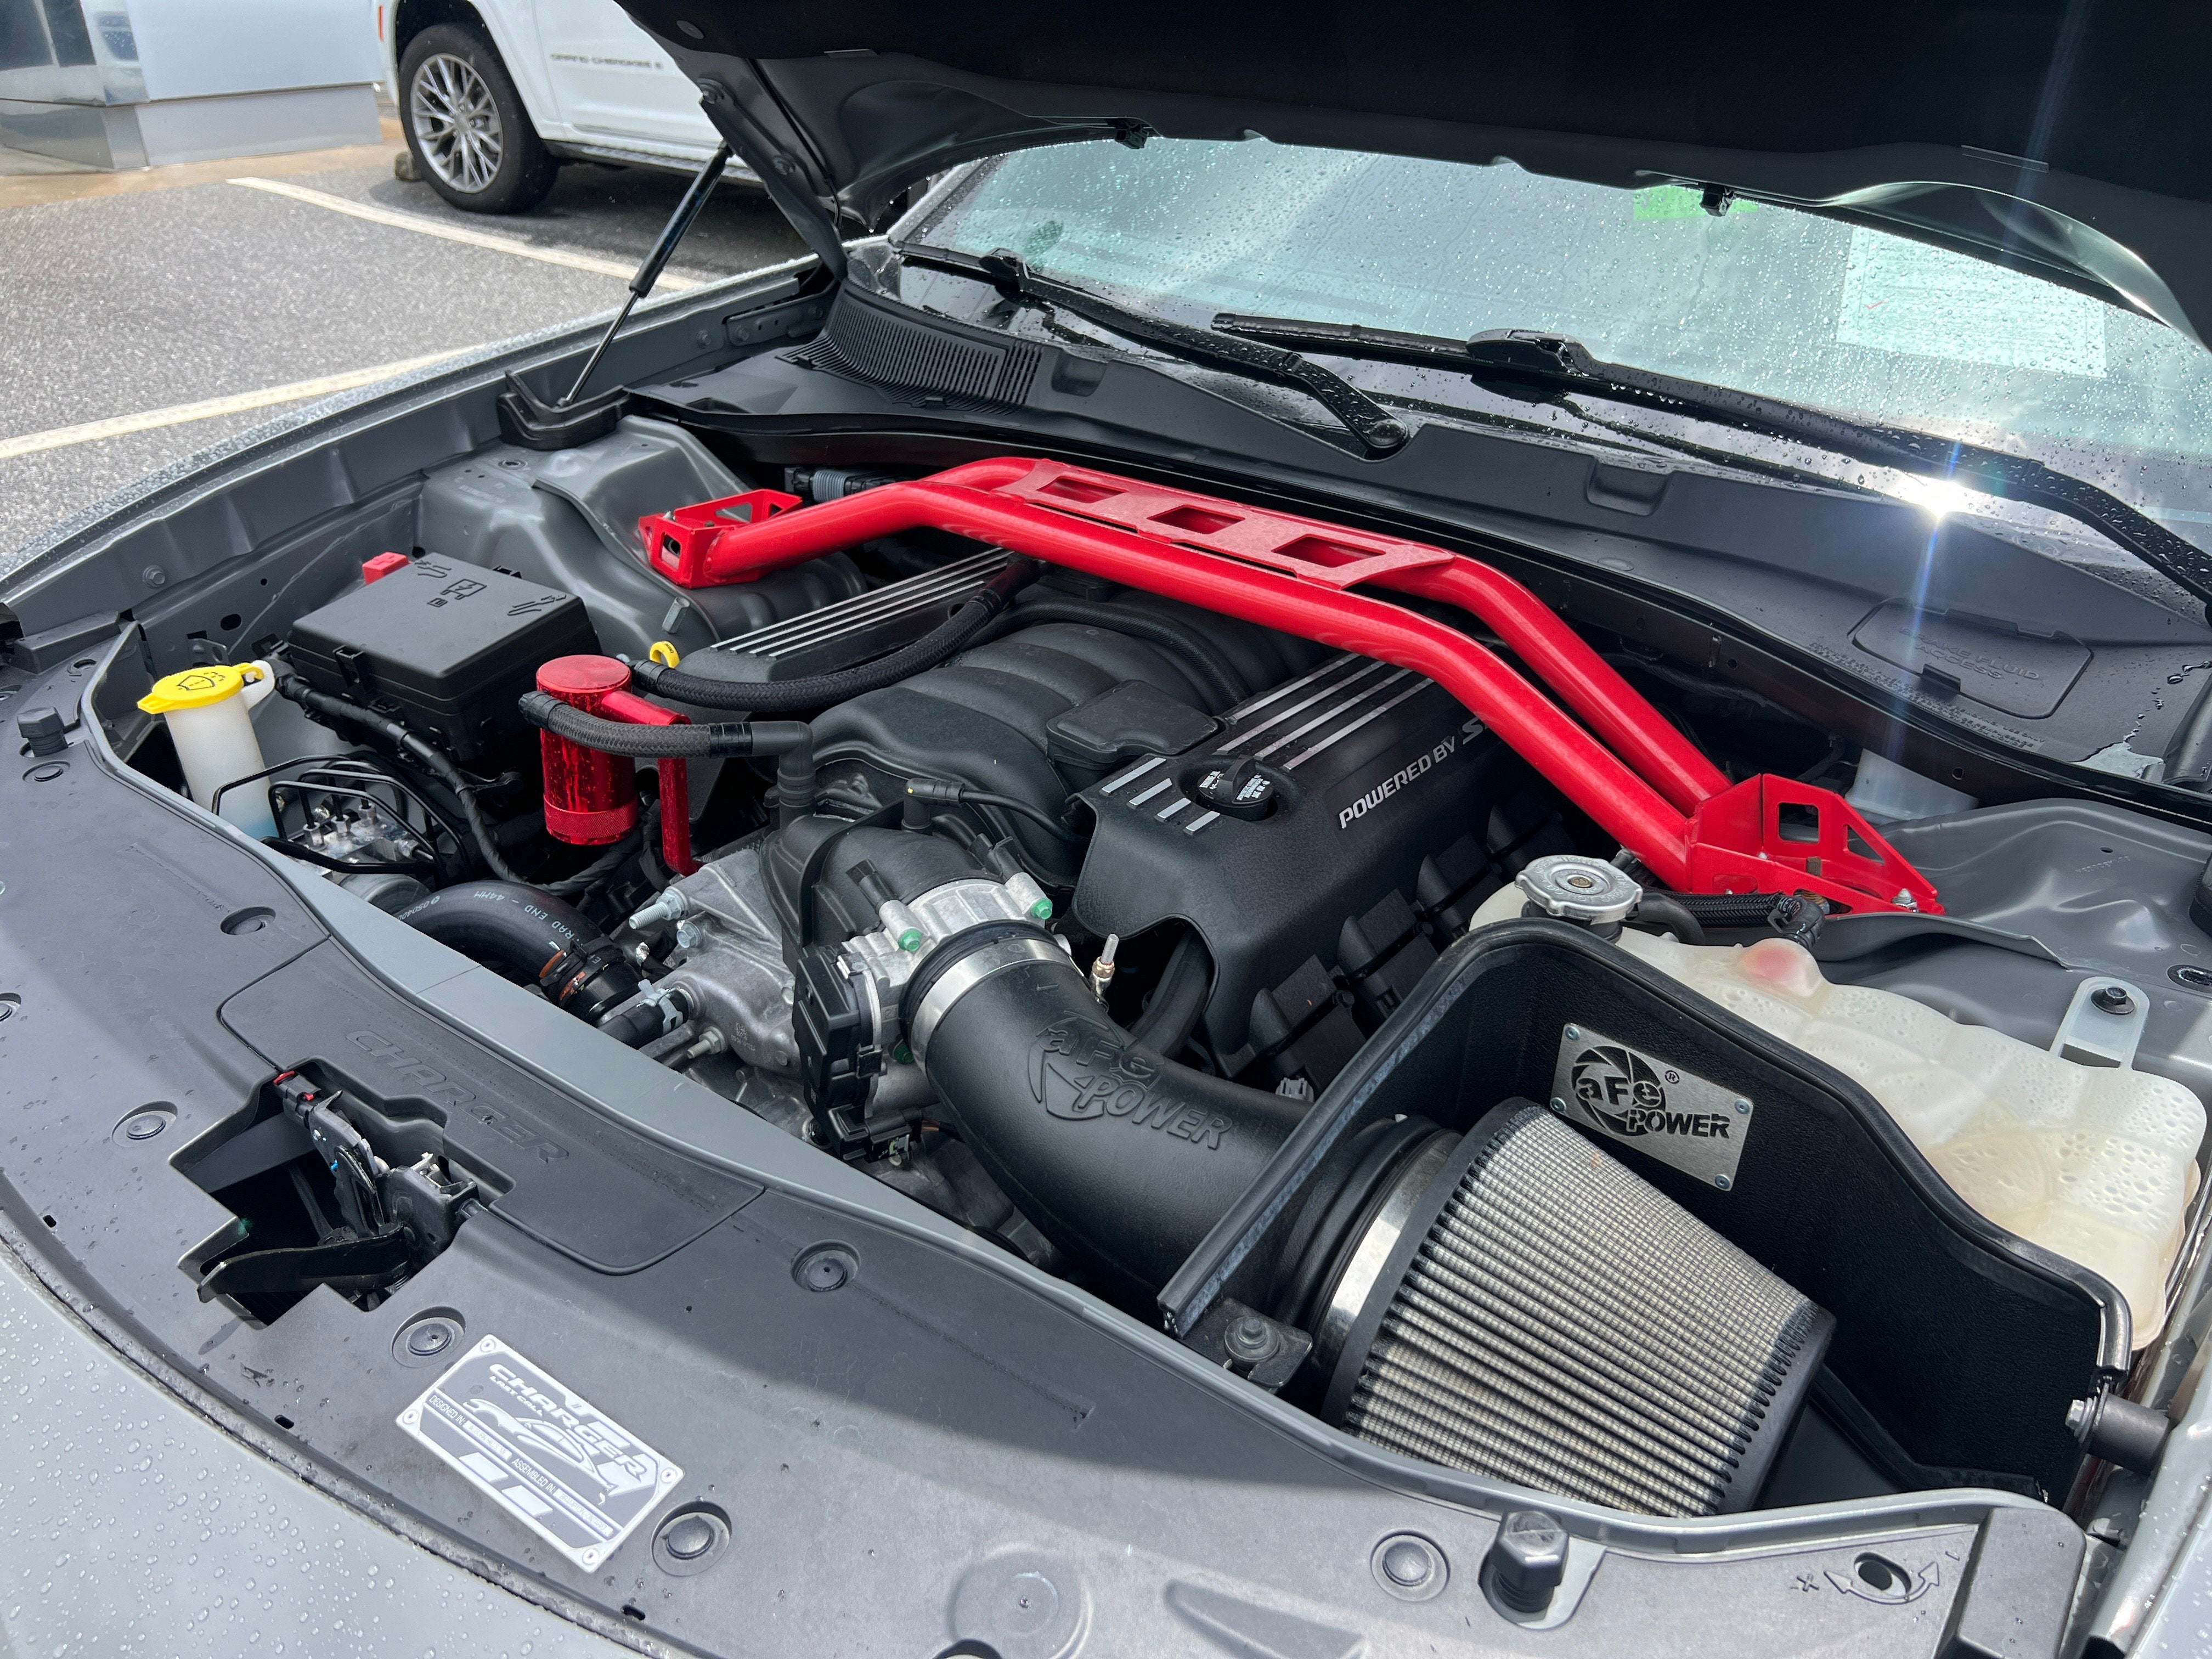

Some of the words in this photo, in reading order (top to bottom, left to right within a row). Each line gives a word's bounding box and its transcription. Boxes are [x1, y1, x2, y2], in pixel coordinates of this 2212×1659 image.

[1915, 645, 2002, 679] ACCESS
[1976, 656, 2039, 680] FLUID
[1339, 754, 1431, 829] POWERED
[1432, 736, 1455, 764] BY
[473, 890, 506, 901] 44MM
[524, 904, 549, 921] END
[551, 921, 576, 940] RAD
[345, 1030, 569, 1164] CHARGER
[1576, 1076, 1661, 1107] aFe
[1077, 1074, 1233, 1150] POWER
[1626, 1108, 1731, 1139] POWER
[489, 1375, 518, 1396] LAST
[516, 1395, 543, 1418] CALL
[489, 1364, 649, 1482] CHARGER
[429, 1395, 459, 1419] DESIGNED
[511, 1458, 549, 1487] ASSEMBLED
